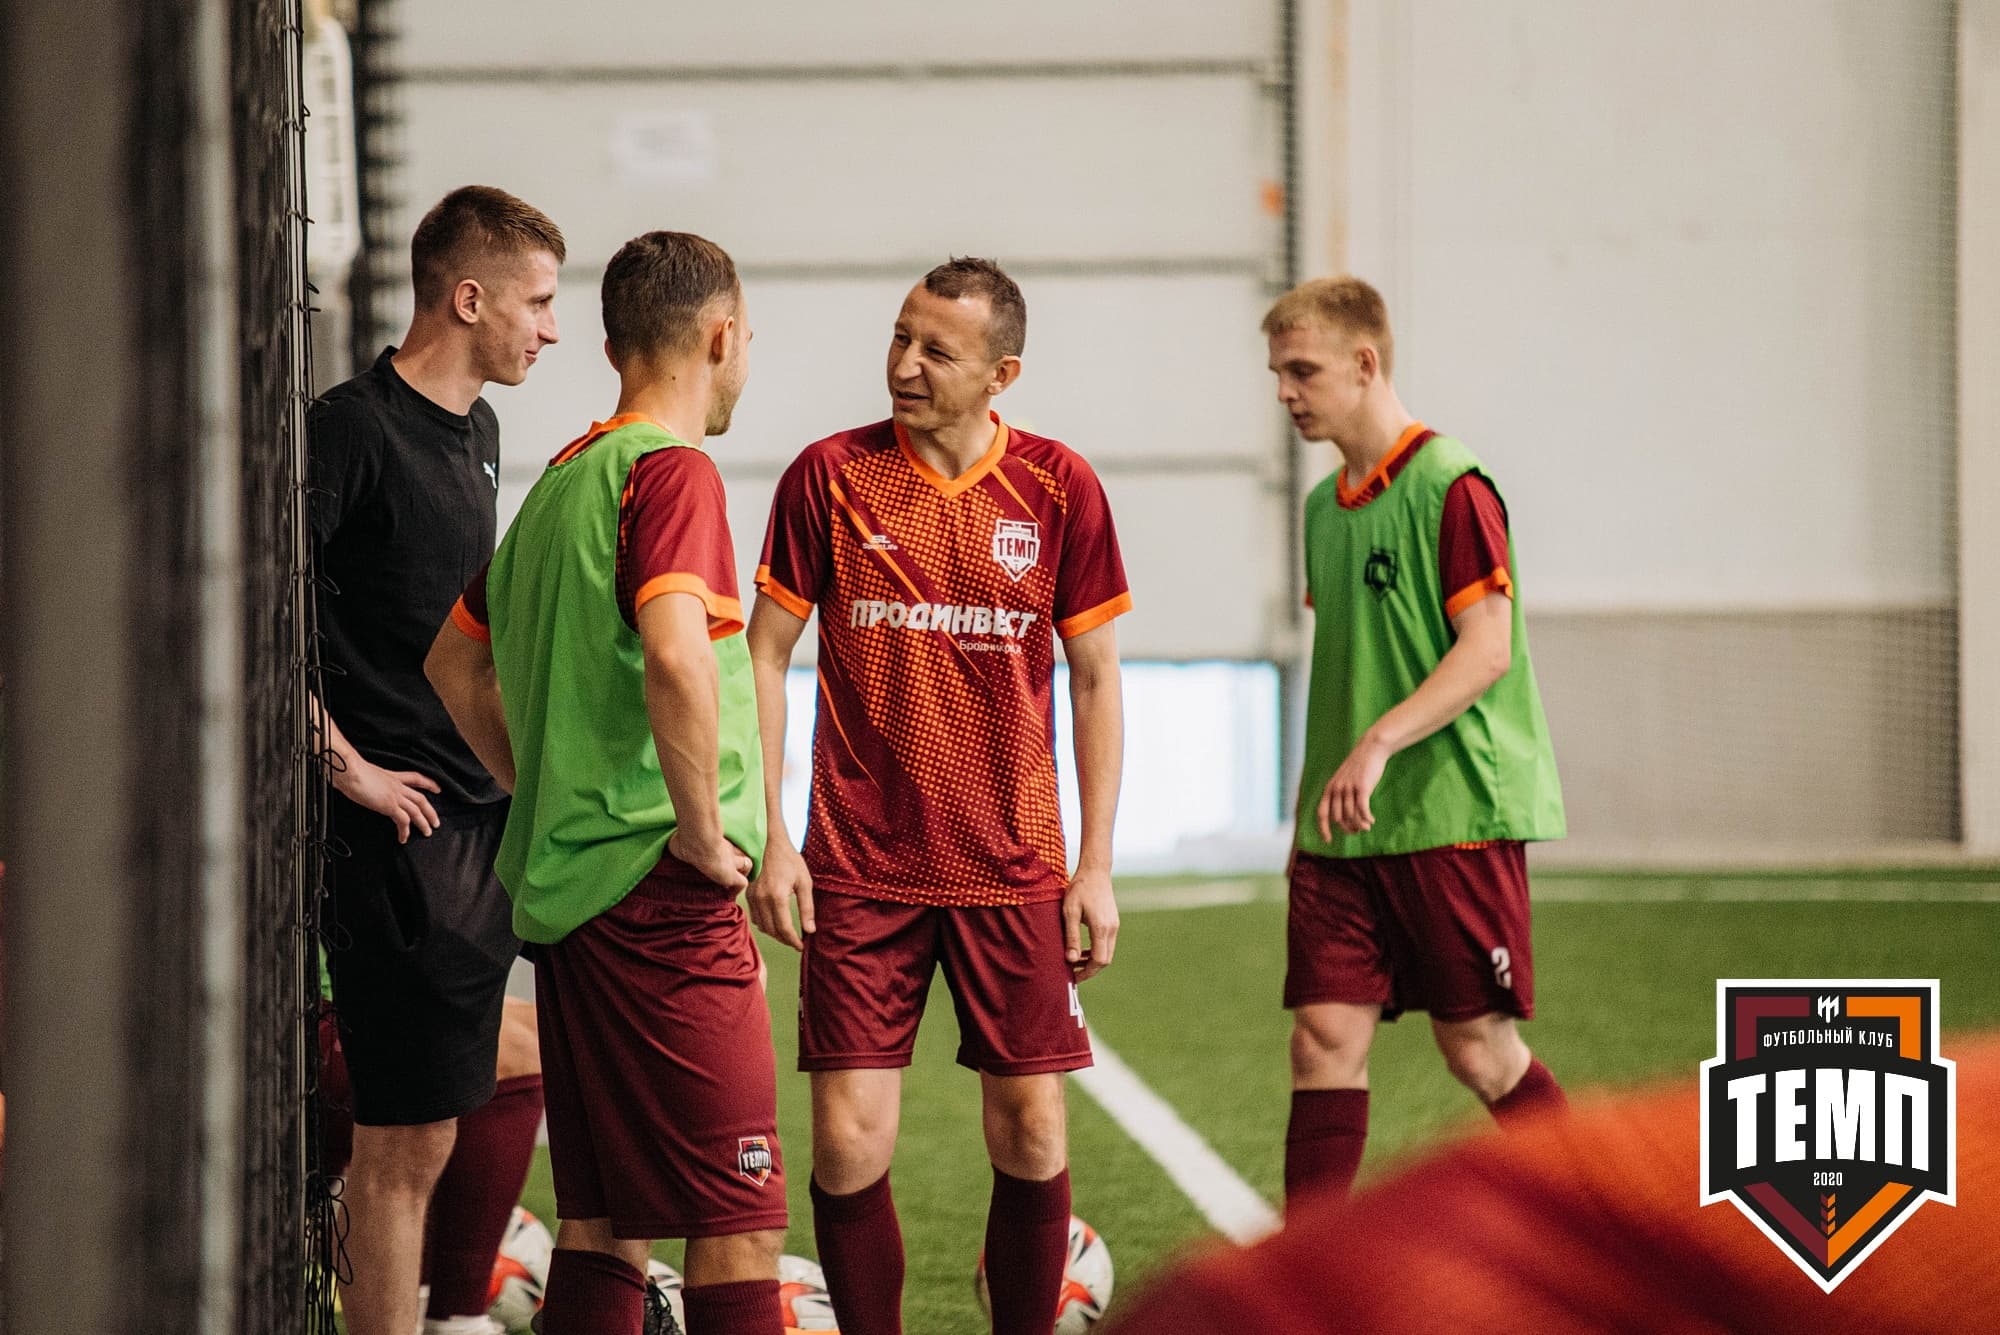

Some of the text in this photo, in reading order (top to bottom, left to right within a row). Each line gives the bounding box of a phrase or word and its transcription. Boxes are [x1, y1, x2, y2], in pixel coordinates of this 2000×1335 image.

[998, 537, 1036, 561] ТЕМП
[851, 599, 1038, 639] ПРОДИНВЕСТ
[1491, 946, 1512, 990] 2
[742, 1150, 769, 1170] ТЕМП
